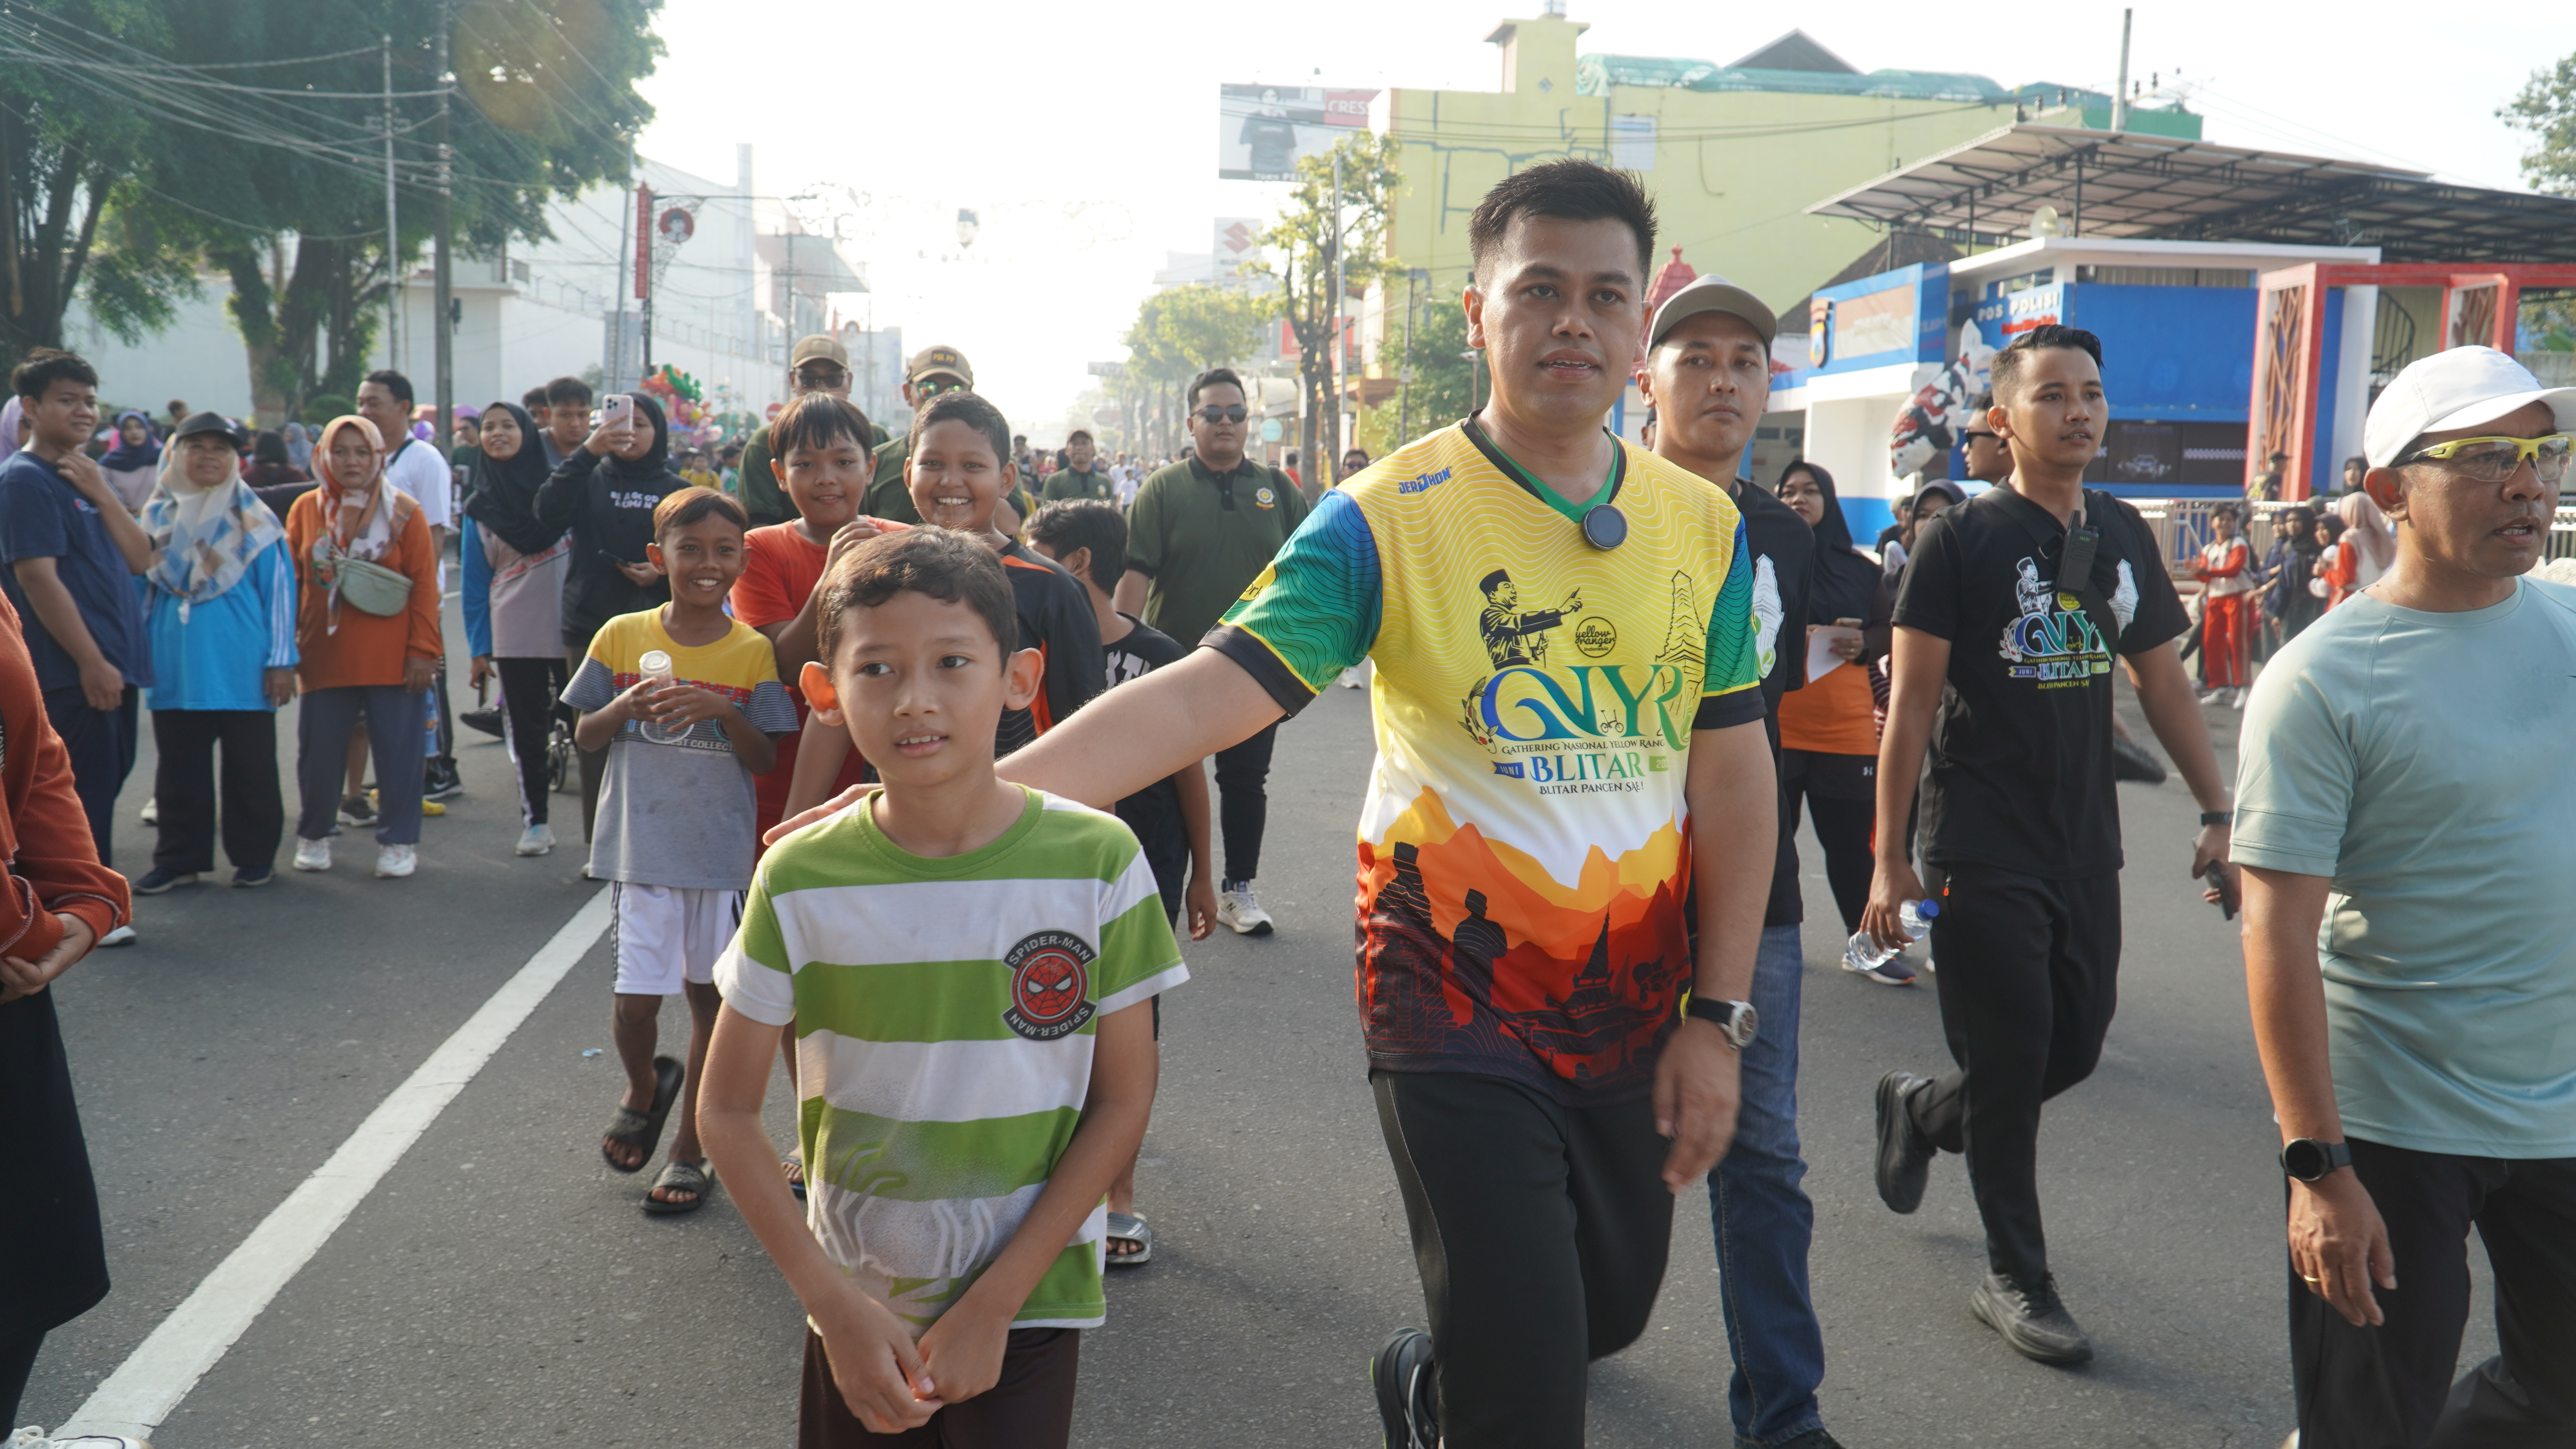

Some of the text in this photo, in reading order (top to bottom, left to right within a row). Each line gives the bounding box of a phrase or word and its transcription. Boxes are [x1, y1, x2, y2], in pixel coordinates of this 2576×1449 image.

[1978, 291, 2059, 321] POS POLISI
[1575, 637, 1616, 647] ranger
[1576, 625, 1611, 638] yellow
[2037, 660, 2090, 681] BLITAR
[1502, 743, 1560, 755] GATHERING
[1561, 741, 1608, 751] NASIONAL
[1609, 740, 1638, 749] YELLOW
[1529, 752, 1646, 782] BLITAR
[1539, 785, 1577, 795] BLITAR
[1581, 783, 1622, 793] PANCEN
[1009, 935, 1091, 965] SPIDER-MAN
[1009, 1007, 1090, 1037] SPIDER-MAN
